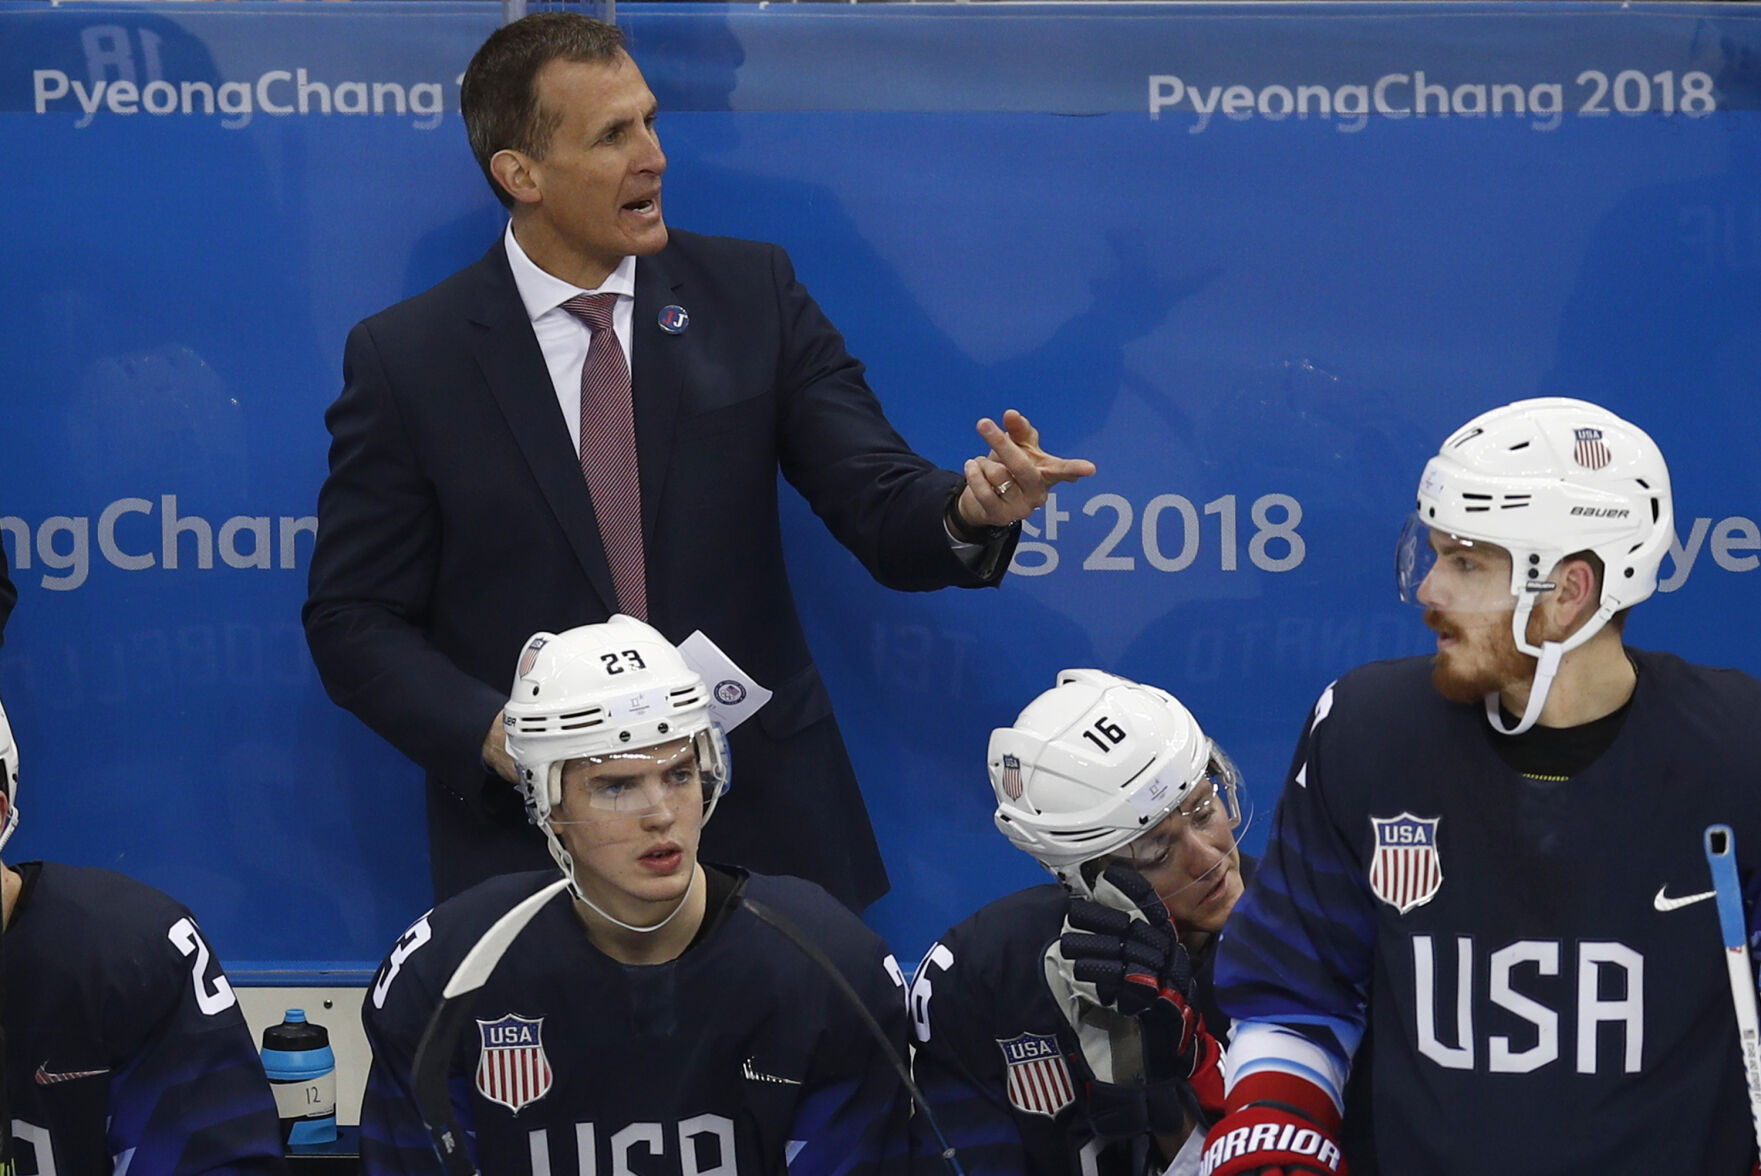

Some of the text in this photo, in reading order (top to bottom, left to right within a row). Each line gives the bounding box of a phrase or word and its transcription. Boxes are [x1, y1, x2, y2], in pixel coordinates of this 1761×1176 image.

[33, 68, 443, 129] PyeongChang
[1149, 69, 1716, 134] PyeongChang 2018
[1577, 430, 1601, 440] USA
[1570, 506, 1630, 519] BAUER
[1082, 493, 1306, 573] 2018
[600, 649, 647, 676] 23
[1083, 716, 1126, 753] 16
[1384, 825, 1427, 844] USA
[1412, 935, 1644, 1074] USA
[490, 1026, 533, 1044] USA
[1010, 1040, 1052, 1059] USA
[305, 1086, 321, 1105] 12
